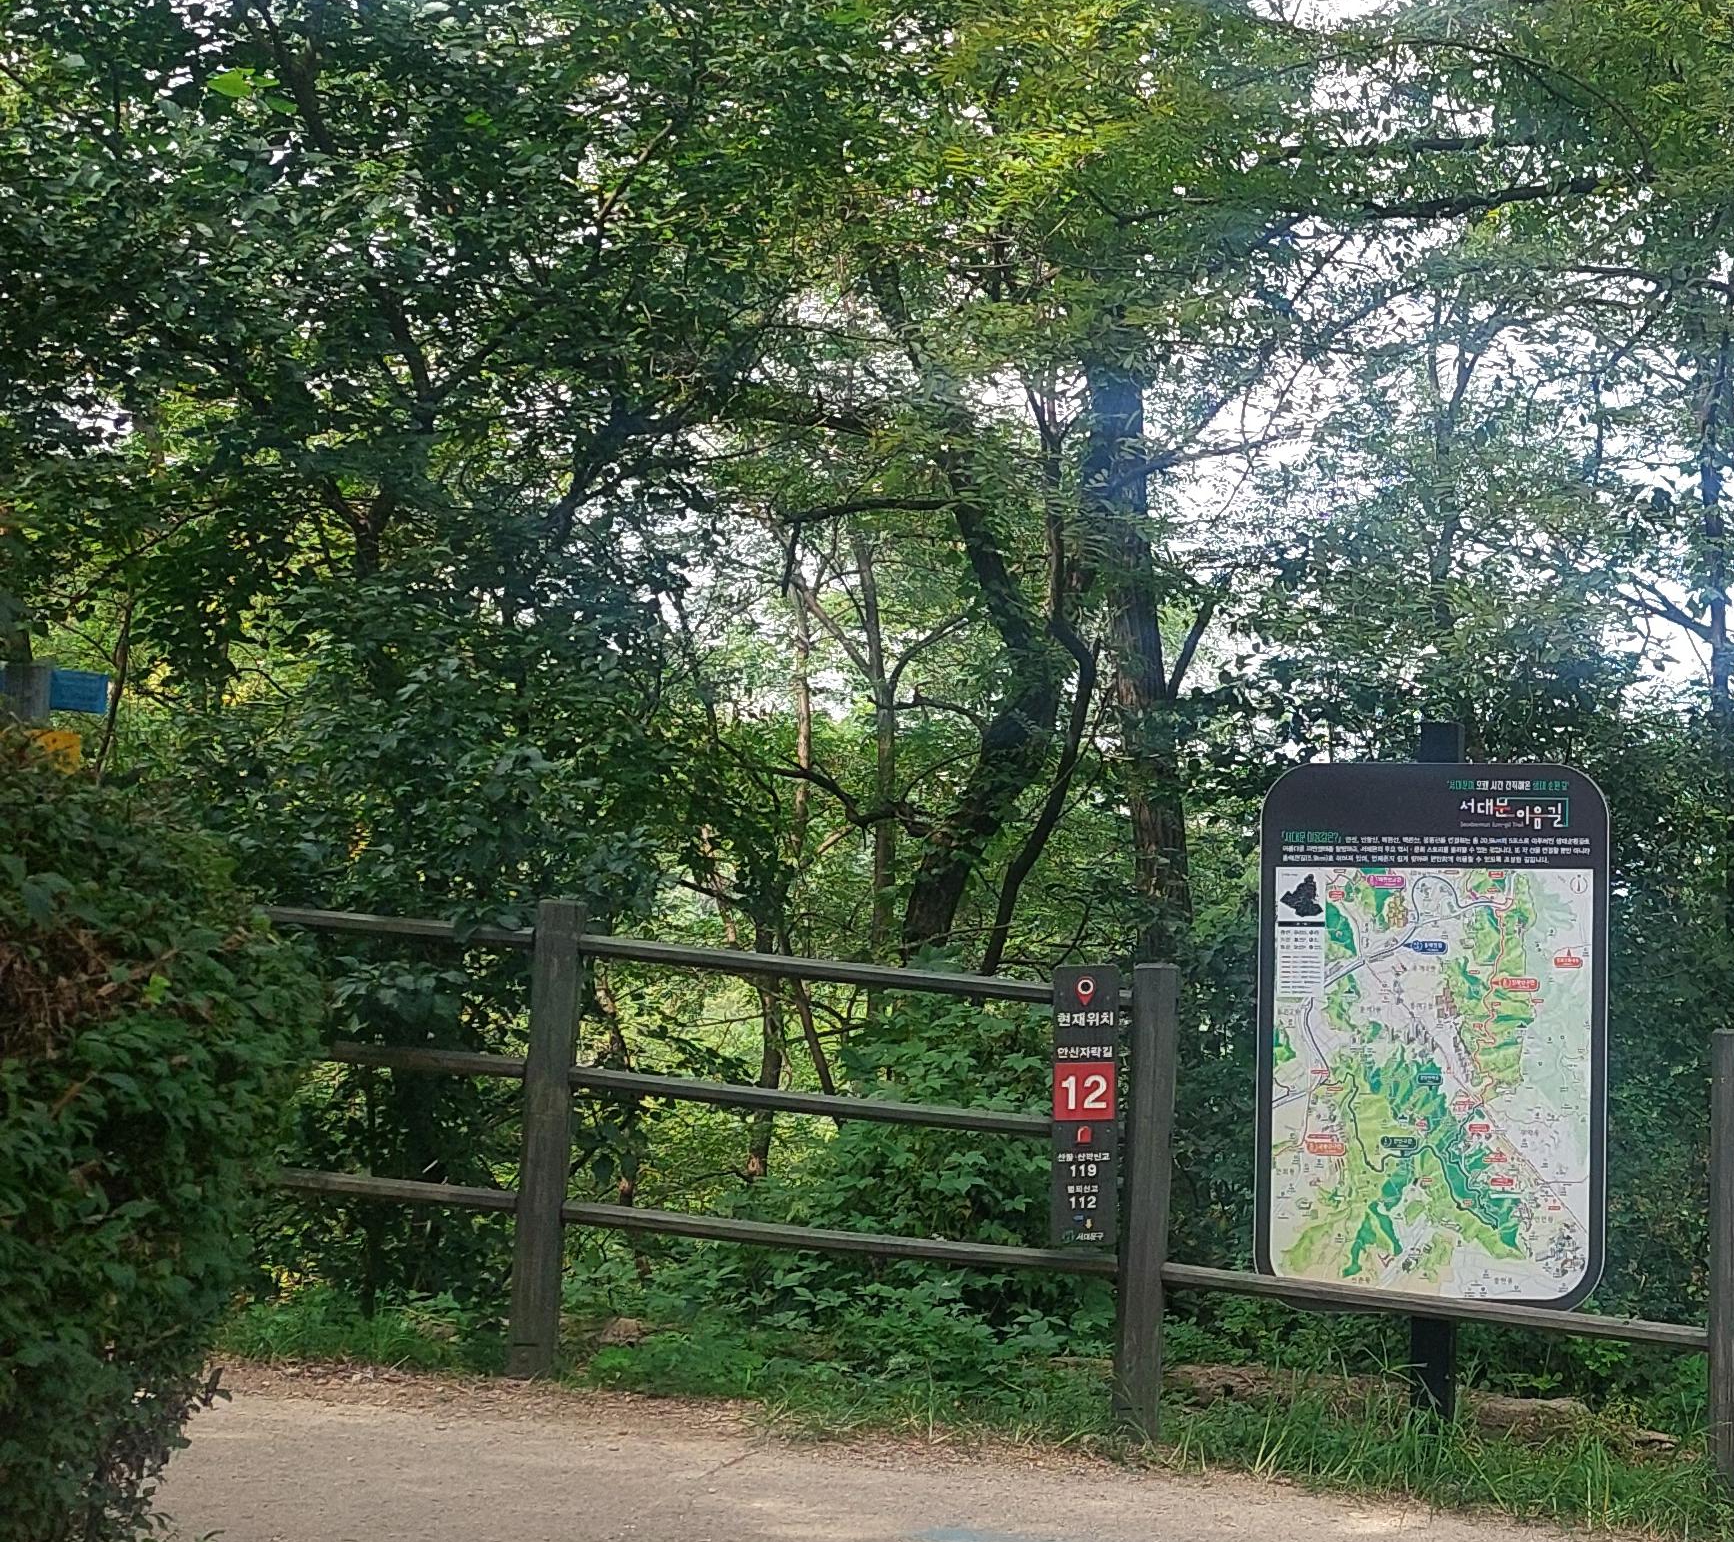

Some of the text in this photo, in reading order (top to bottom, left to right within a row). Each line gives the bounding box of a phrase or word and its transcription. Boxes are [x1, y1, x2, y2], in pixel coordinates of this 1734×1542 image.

[1057, 1011, 1114, 1028] 현재위치
[1057, 1046, 1113, 1059] 안산자락길
[1061, 1074, 1107, 1111] 12
[1070, 1164, 1098, 1179] 119
[1069, 1195, 1098, 1210] 112
